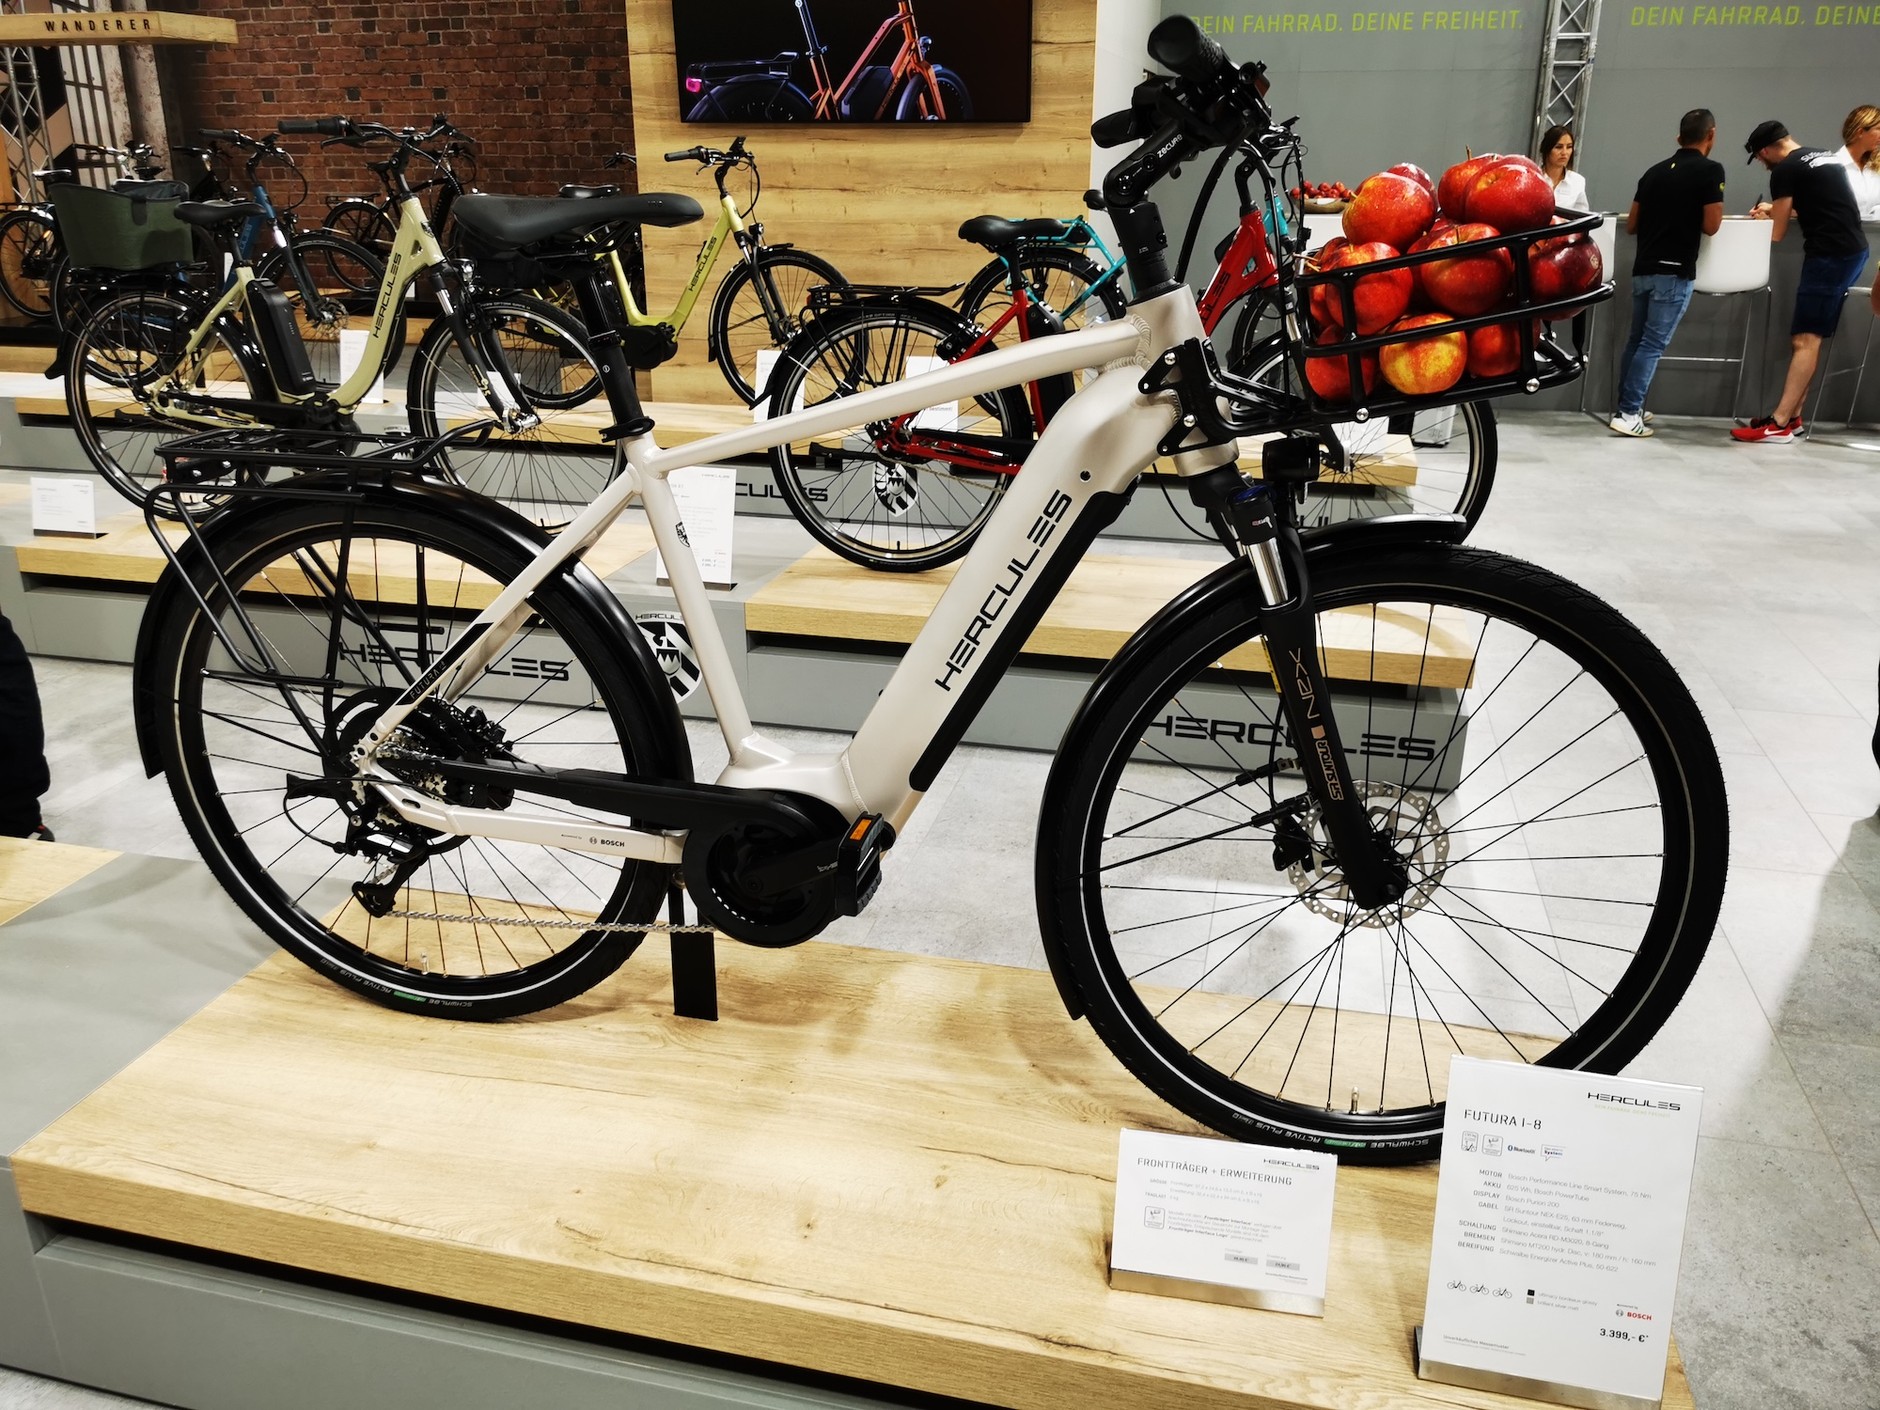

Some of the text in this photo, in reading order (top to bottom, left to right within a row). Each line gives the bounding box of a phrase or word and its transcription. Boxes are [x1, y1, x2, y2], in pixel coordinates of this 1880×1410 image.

[1243, 14, 1343, 33] FAHRRAD.
[1352, 12, 1414, 32] DEINE
[1422, 10, 1523, 31] FREIHEIT.
[1631, 6, 1684, 26] DEIN
[1693, 5, 1805, 25] FAHRRAD.
[45, 19, 151, 32] WANDERER
[688, 236, 717, 291] HERCULES
[372, 252, 402, 338] HERCULES
[935, 489, 1073, 691] HERCULES
[635, 613, 682, 621] HERCUL
[409, 669, 440, 699] FUTURA
[1150, 714, 1436, 761] HERCES
[600, 839, 625, 847] BOSCH
[339, 970, 361, 983] PLUS
[363, 980, 392, 994] ACTIVE
[1587, 1092, 1681, 1111] HERCULES
[1464, 1109, 1542, 1130] FUTURA I-8
[1255, 1122, 1283, 1136] PLUS
[1285, 1131, 1321, 1144] ACTIVE
[1370, 1138, 1429, 1149] SCHWALBE
[1137, 1157, 1208, 1175] FRONTTRÄGER
[1220, 1168, 1292, 1186] ERWEITERUNG
[1263, 1158, 1320, 1170] HERCULES
[1479, 1169, 1502, 1178] MOTOR
[1508, 1173, 1528, 1181] Bosch
[1529, 1176, 1568, 1188] Performance
[1569, 1182, 1582, 1190] Line
[1584, 1184, 1602, 1193] Smart
[1483, 1180, 1501, 1189] AKKU
[1534, 1188, 1553, 1197] Bosch
[1473, 1190, 1500, 1199] DISPLAY
[1505, 1195, 1525, 1203] Bosch
[1478, 1201, 1499, 1210] GABEL
[1459, 1219, 1497, 1231] SCHALTUNG
[1501, 1226, 1529, 1237] Shimano
[1464, 1231, 1496, 1241] BREMSEN
[1500, 1237, 1527, 1248] Shimano
[1457, 1241, 1494, 1252] BEREIFUNG
[1499, 1248, 1529, 1258] Schwalbe
[1626, 1311, 1652, 1321] BOSCH
[1599, 1328, 1636, 1342] 3.399,-
